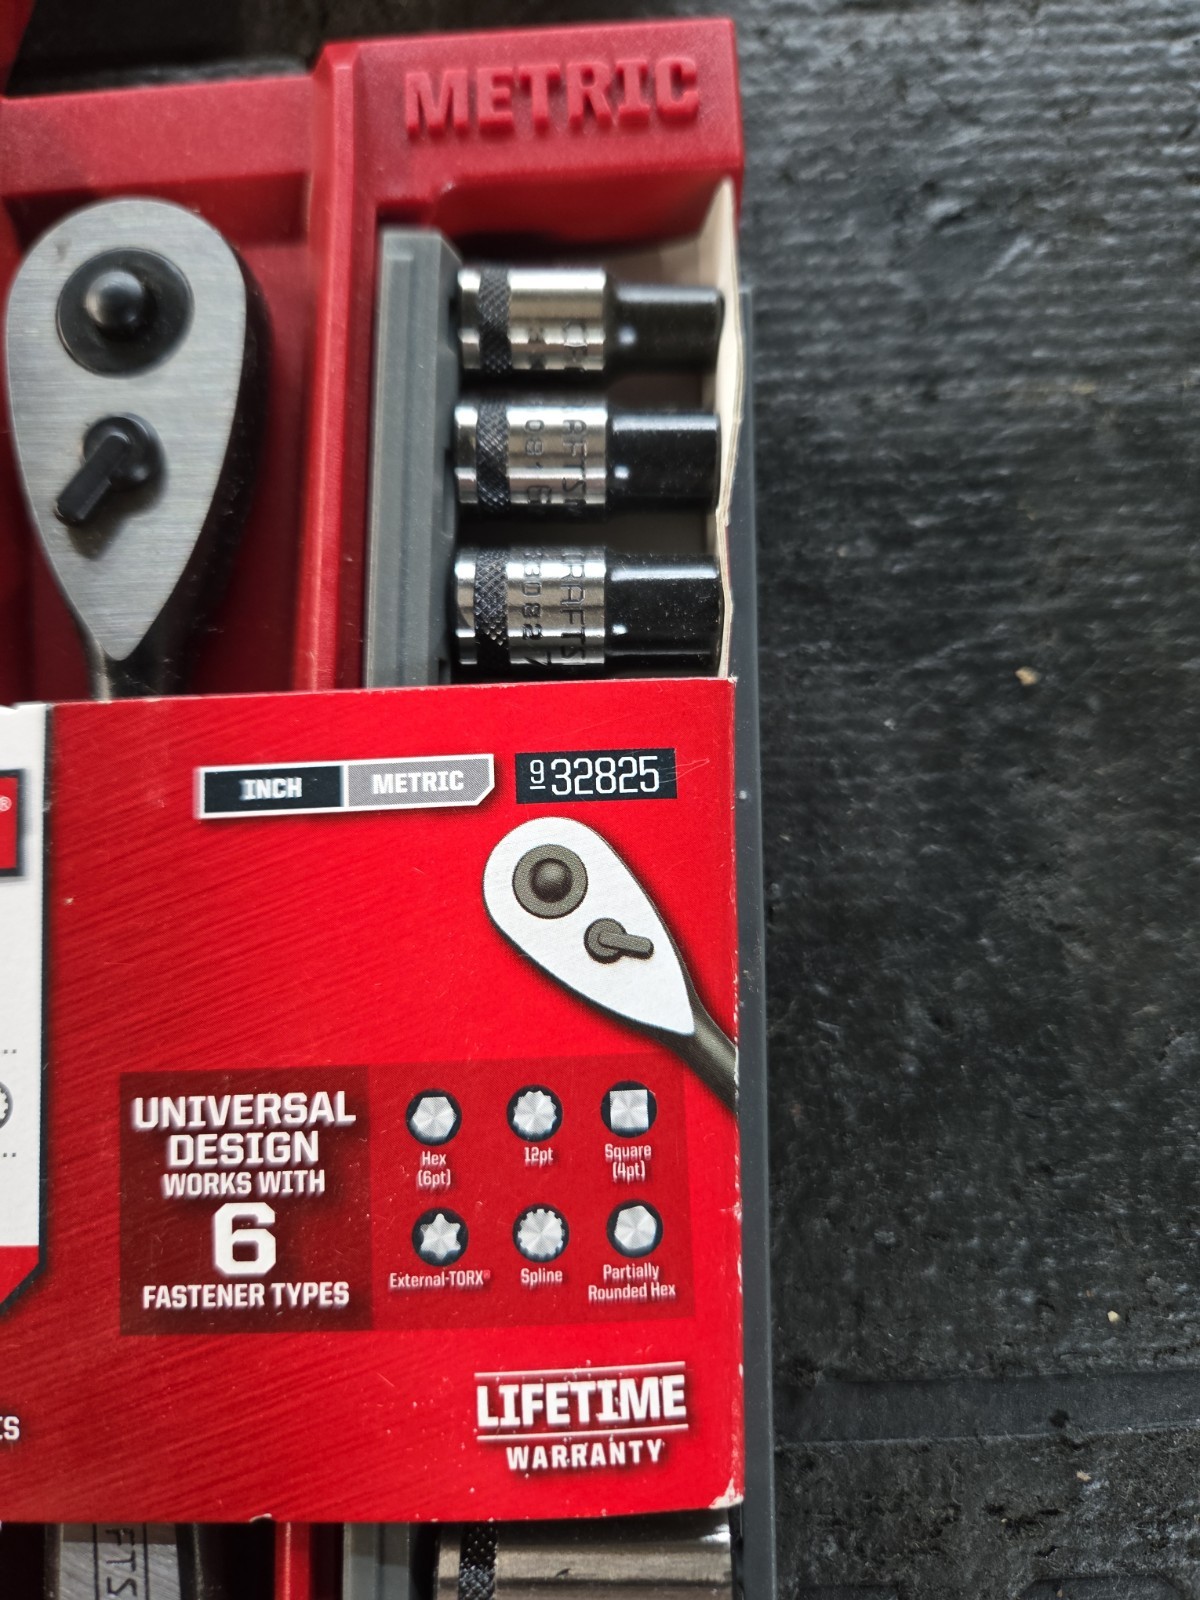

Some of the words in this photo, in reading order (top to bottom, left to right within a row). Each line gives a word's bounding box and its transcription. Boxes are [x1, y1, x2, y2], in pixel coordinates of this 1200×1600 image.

[404, 57, 699, 138] METRIC
[238, 777, 303, 801] INCH
[371, 769, 465, 796] METRIC
[132, 1090, 358, 1131] UNIVERSAL
[167, 1130, 319, 1169] DESIGN
[420, 1150, 447, 1168] Hex
[523, 1146, 554, 1165] 12pt
[604, 1142, 652, 1161] Square
[162, 1171, 252, 1199] WORKS
[257, 1168, 326, 1197] WITH
[417, 1169, 452, 1189] (6pt)
[611, 1160, 647, 1181] (4pt)
[212, 1201, 277, 1277] 6
[520, 1267, 563, 1286] Spline
[602, 1262, 660, 1282] Partially
[142, 1282, 266, 1310] FASTENER
[270, 1280, 350, 1308] TYPES
[587, 1283, 648, 1303] Rounded
[650, 1281, 677, 1301] Hex
[476, 1374, 688, 1429] LIFETIME
[0, 1415, 20, 1441] S
[505, 1438, 664, 1472] WARRANTY
